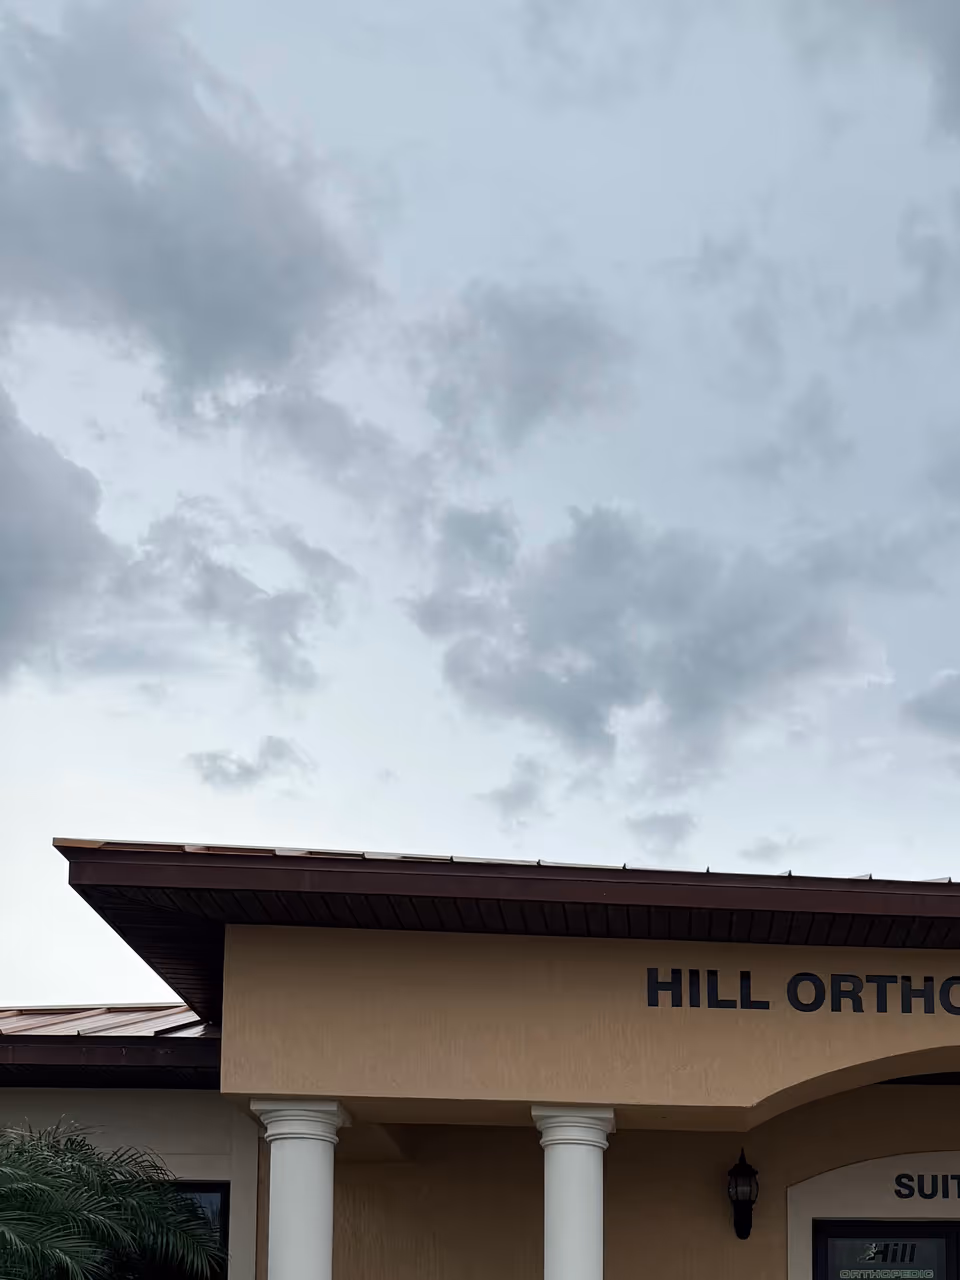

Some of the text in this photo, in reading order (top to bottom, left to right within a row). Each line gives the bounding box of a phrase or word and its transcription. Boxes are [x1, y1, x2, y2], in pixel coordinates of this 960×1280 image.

[647, 967, 770, 1010] HILL
[866, 1243, 917, 1263] Hill
[840, 1270, 934, 1279] ORTHOPEDIC
